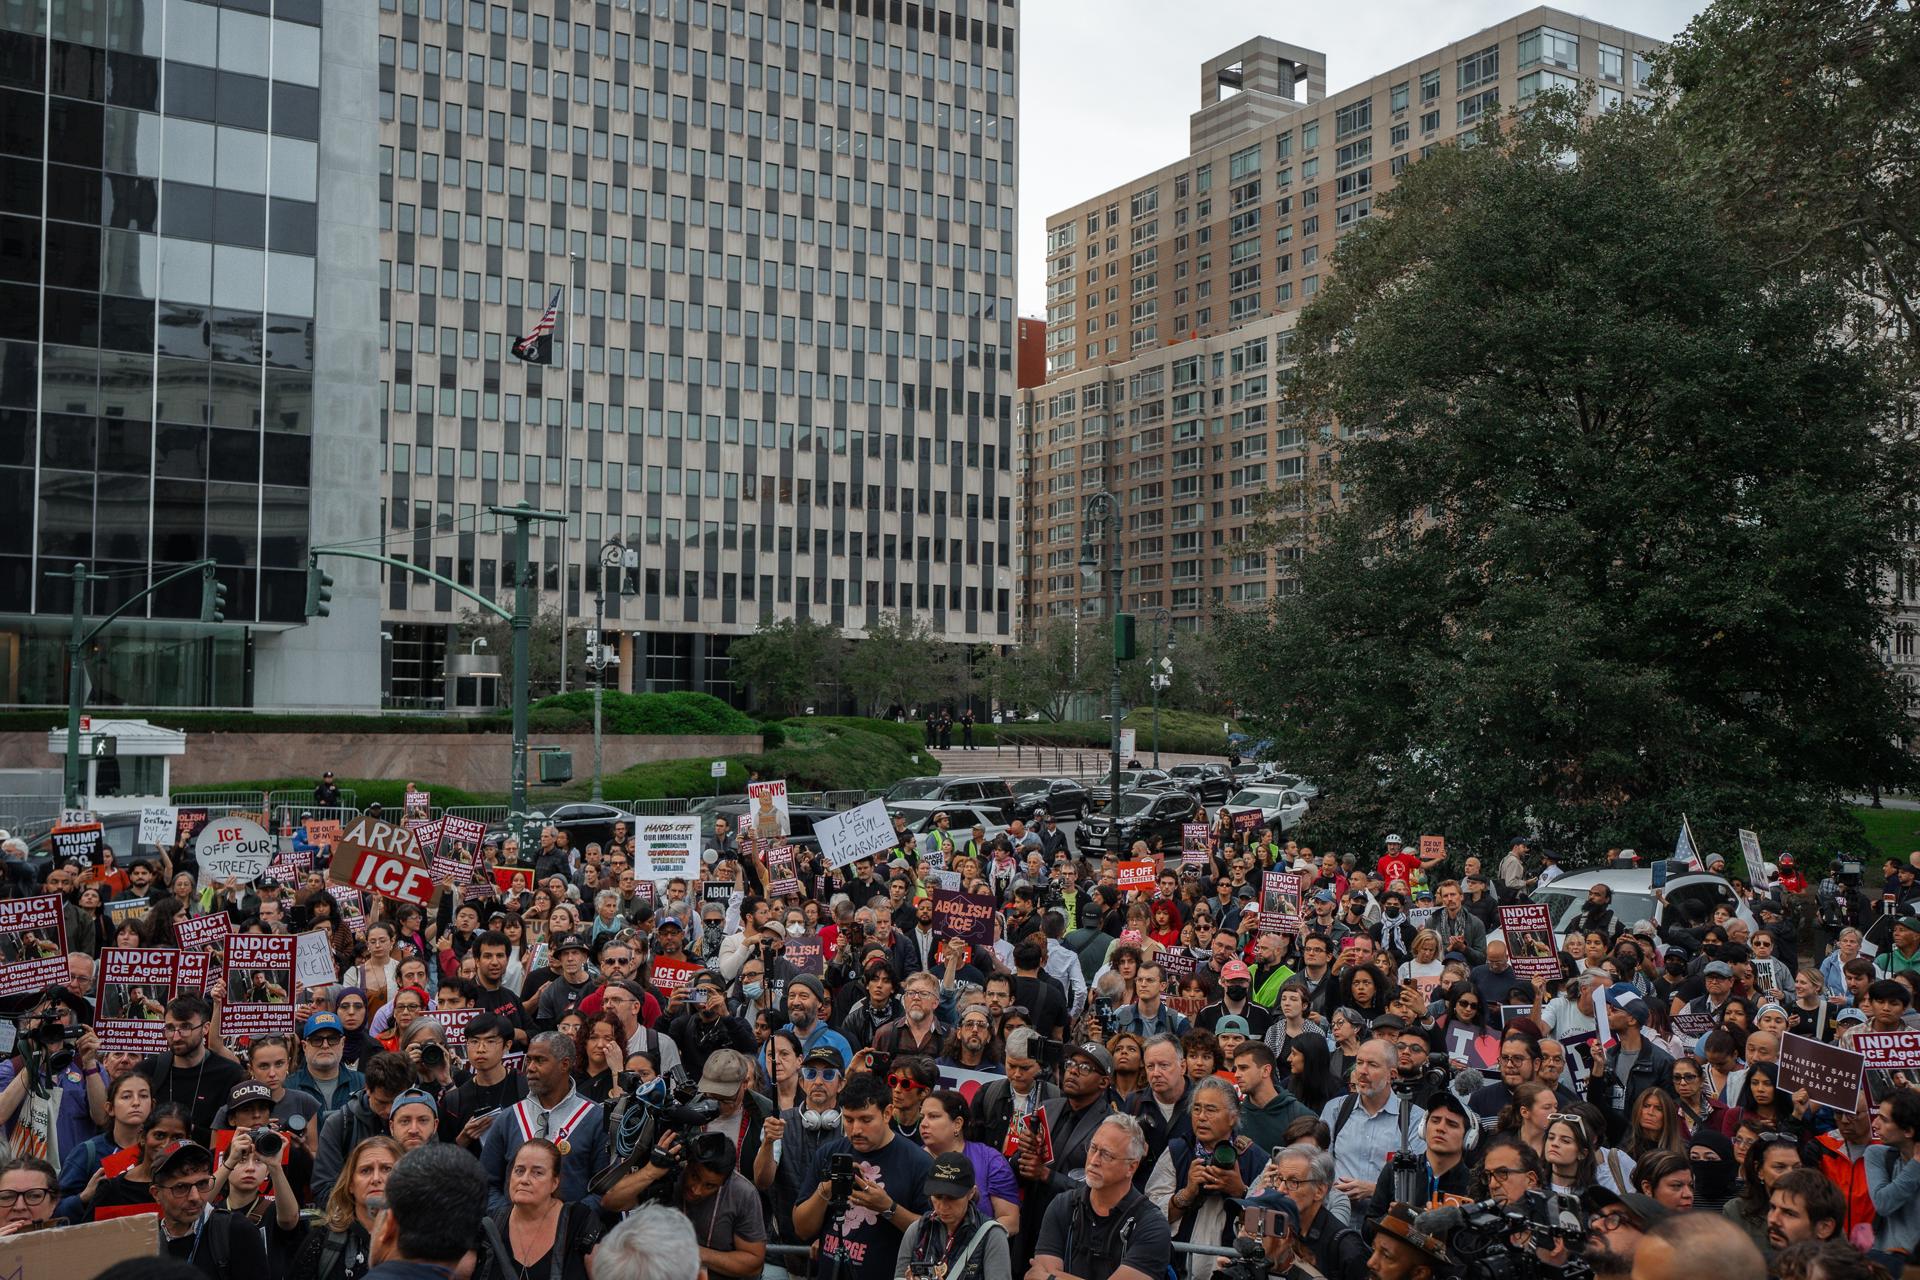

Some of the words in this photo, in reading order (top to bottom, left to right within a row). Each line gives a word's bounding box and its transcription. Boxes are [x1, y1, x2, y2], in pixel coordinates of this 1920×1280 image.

[749, 785, 764, 799] NOT
[769, 782, 785, 797] NYC
[65, 812, 92, 823] ICE
[839, 807, 864, 829] ICE
[1235, 813, 1262, 822] ABOLISH
[179, 821, 195, 830] ICE
[446, 816, 483, 832] INDICT
[645, 824, 673, 833] HANDS
[675, 824, 695, 832] OFF
[217, 828, 244, 843] ICE
[444, 824, 458, 834] ICE
[458, 828, 481, 839] Agent
[657, 833, 693, 841] IMMIGRANT
[832, 830, 847, 846] IS
[854, 816, 885, 837] EVIL
[54, 831, 100, 846] TRUMP
[343, 819, 422, 861] ARRE
[418, 833, 434, 842] ICE
[60, 842, 97, 857] MUST
[202, 843, 230, 856] OFF
[236, 840, 271, 853] OUR
[769, 847, 791, 857] INDICT
[831, 831, 894, 866] INCARNATE
[281, 852, 311, 860] INDICT
[924, 852, 943, 860] HANDS
[208, 860, 262, 876] STREETS
[265, 864, 295, 875] INDICT
[1120, 868, 1135, 878] ICE
[1136, 866, 1153, 876] OFF
[1266, 873, 1299, 884] INDICT
[1279, 882, 1298, 890] Agent
[0, 897, 57, 915] NDICT
[934, 900, 993, 919] ABOLISH
[0, 914, 17, 924] CE
[21, 909, 58, 923] Agent
[1502, 907, 1544, 918] INDICT
[178, 914, 225, 934] INDICT
[948, 917, 973, 931] ICE
[1521, 916, 1546, 925] Agent
[181, 930, 197, 941] ICE
[199, 924, 228, 938] Agent
[183, 936, 208, 948] Brendan
[230, 937, 292, 951] INDICT
[230, 950, 251, 960] ICE
[254, 950, 292, 961] Agent
[785, 945, 820, 956] OLISH
[107, 951, 175, 966] INDICT
[180, 955, 206, 967] ICT
[229, 960, 267, 968] Brendan
[270, 960, 291, 968] Cuni
[1155, 952, 1195, 966] INDICT
[106, 965, 129, 974] ICE
[133, 965, 173, 977] Agent
[654, 966, 675, 980] ICE
[1172, 963, 1193, 972] Agent
[9, 970, 36, 980] Oscar
[105, 975, 146, 983] Brendan
[149, 975, 172, 983] Cuni
[652, 979, 667, 987] OUR
[233, 1005, 268, 1013] ATTEMPTED
[1674, 1014, 1709, 1023] INDICT
[1695, 1022, 1714, 1030] Agent
[107, 1029, 136, 1037] Oscar
[137, 1030, 163, 1039] Belga
[1448, 1028, 1474, 1064] I
[1889, 1049, 1920, 1060] Agen
[1783, 1052, 1793, 1061] WE
[1795, 1058, 1826, 1072] AREN'T
[1831, 1068, 1857, 1080] SAFE
[1864, 1059, 1905, 1067] Brendan
[1781, 1061, 1801, 1074] UNTIL
[1804, 1070, 1821, 1080] ALL
[1825, 1076, 1838, 1085] OF
[1843, 1081, 1857, 1090] US
[1791, 1075, 1804, 1085] ARE
[1808, 1081, 1837, 1095] SAFE.
[232, 1085, 271, 1099] GOLDEN
[823, 1234, 868, 1262] EMRGE
